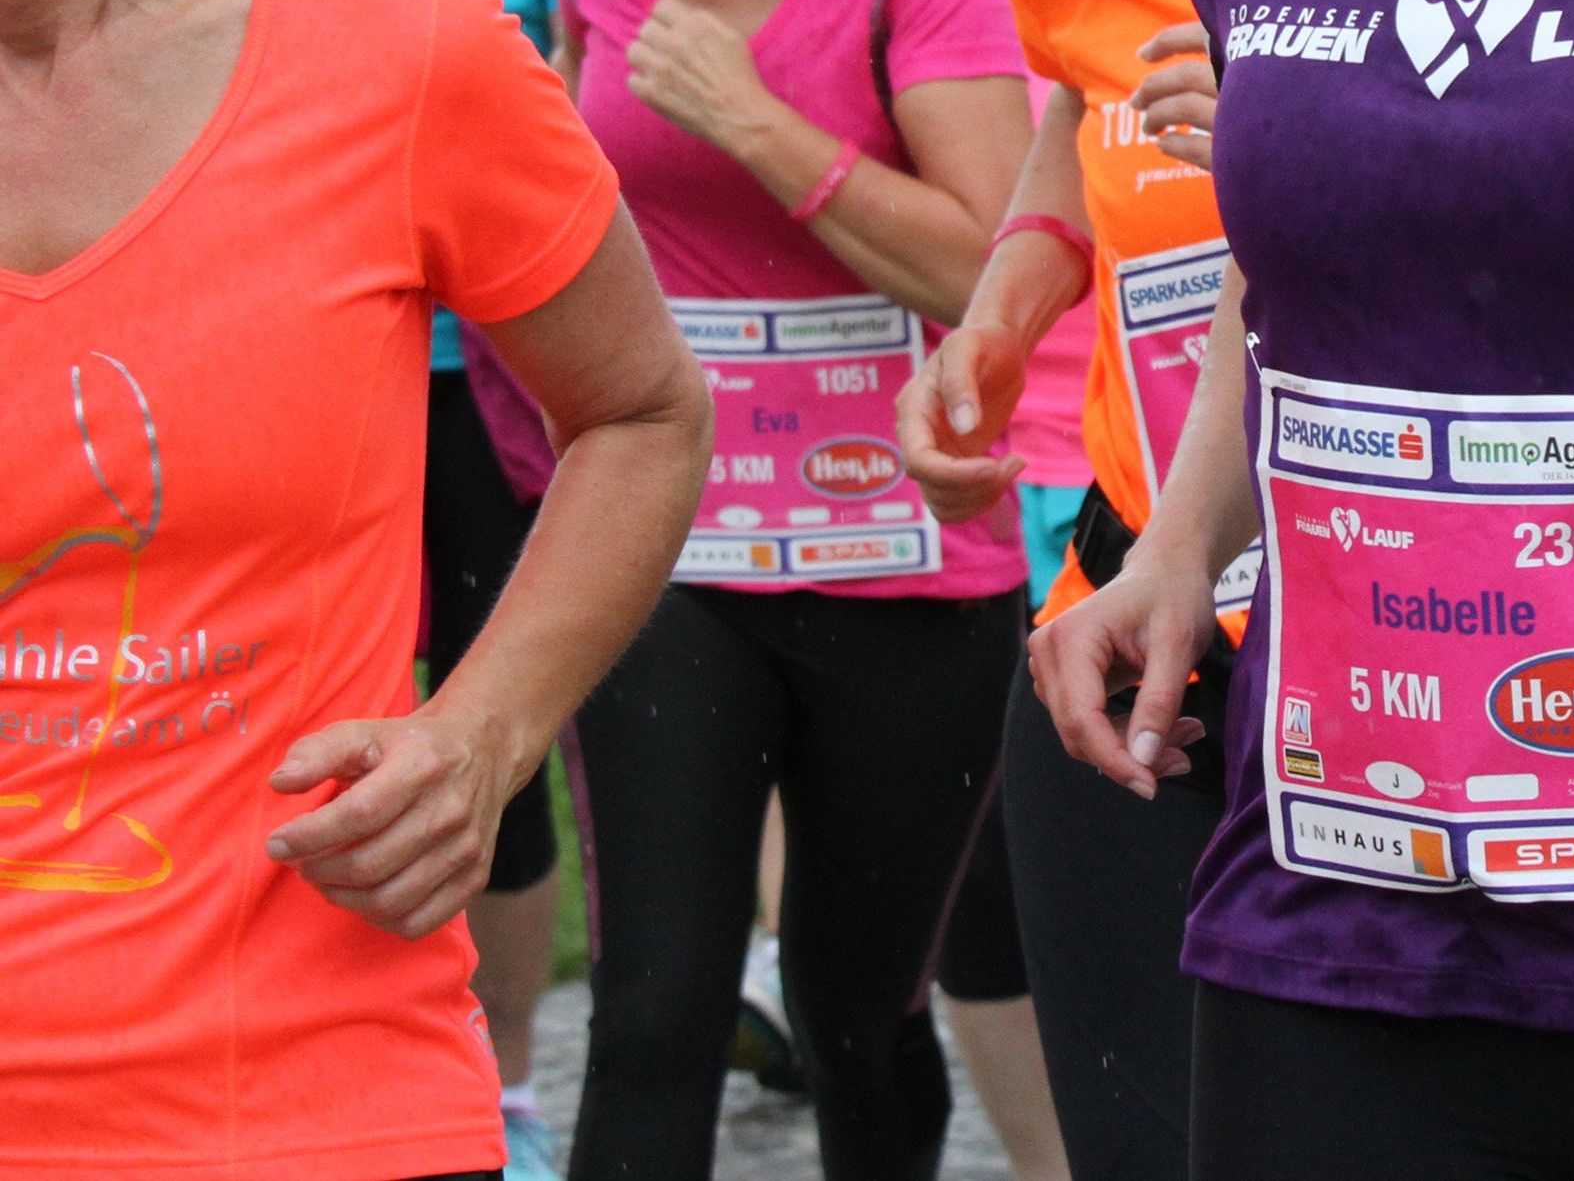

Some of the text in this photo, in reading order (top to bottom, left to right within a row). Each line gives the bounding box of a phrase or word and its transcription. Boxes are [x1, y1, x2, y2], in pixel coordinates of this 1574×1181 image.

[1230, 4, 1384, 29] BODENSEE
[1226, 22, 1375, 63] FRAUEN
[1129, 270, 1222, 308] SPARKASSE
[815, 365, 878, 395] 1051
[753, 407, 799, 434] Eva
[1282, 415, 1395, 459] SPARKASSE
[732, 455, 775, 483] KM
[811, 451, 898, 484] Hervis
[1362, 527, 1415, 549] LAUF
[1371, 581, 1537, 637] Isabelle
[114, 629, 268, 685] Sailer
[1350, 666, 1442, 723] 5 KM
[112, 714, 184, 747] am
[201, 691, 249, 735] Öl
[1300, 822, 1404, 857] INHAUS
